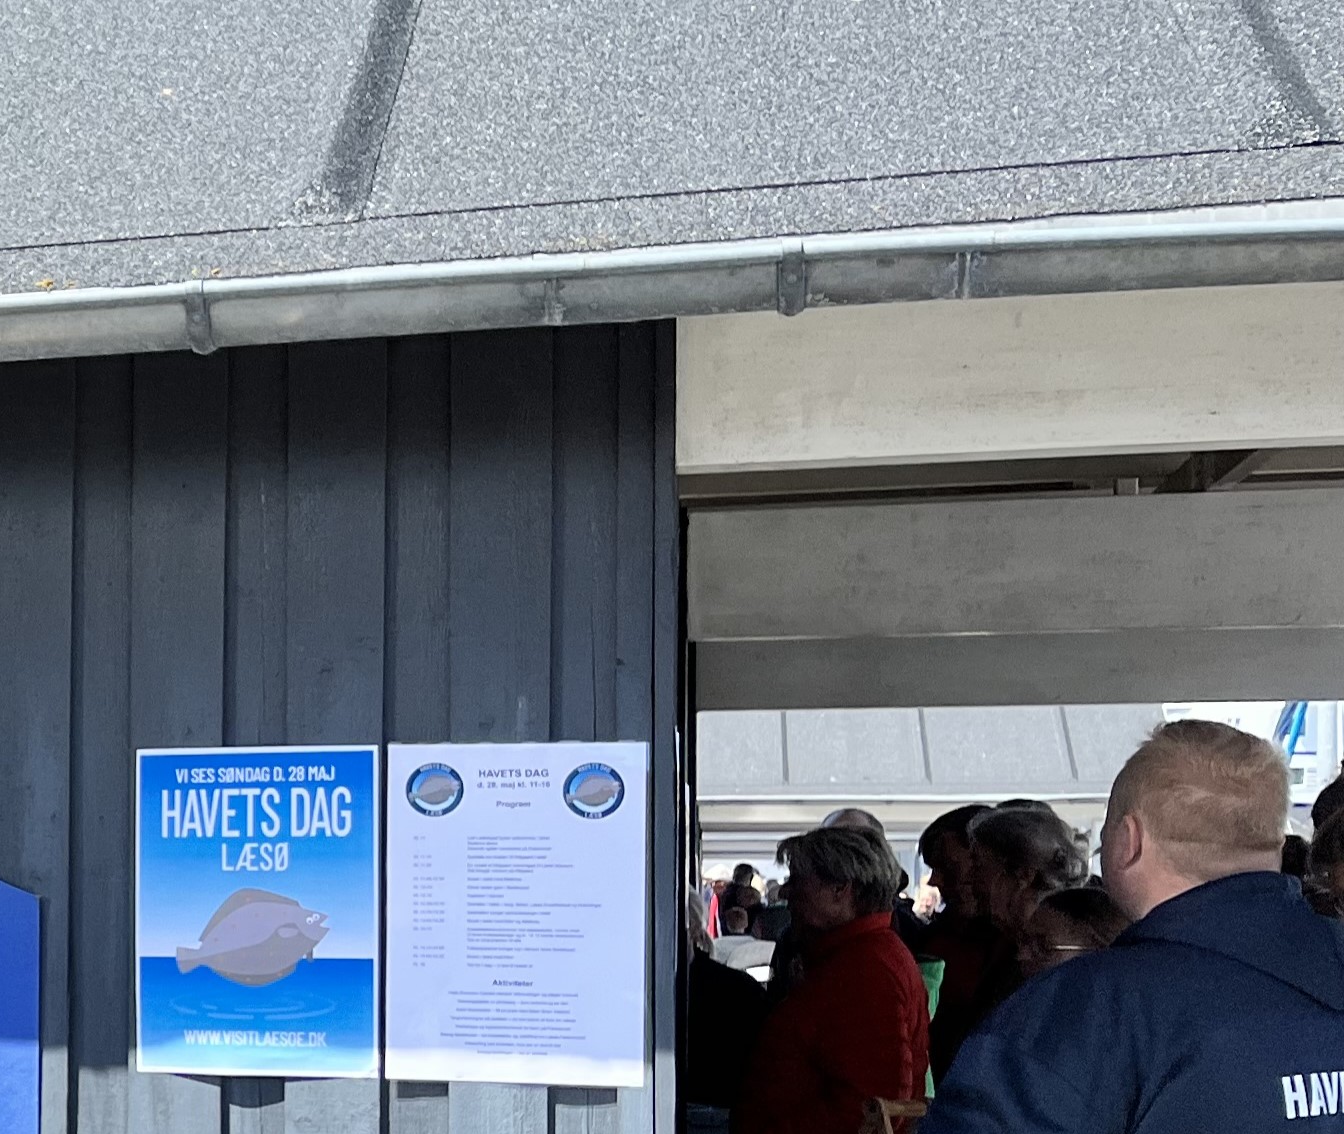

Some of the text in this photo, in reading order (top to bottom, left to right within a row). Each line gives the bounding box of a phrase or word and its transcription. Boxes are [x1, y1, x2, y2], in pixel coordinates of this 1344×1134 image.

[175, 765, 336, 784] VI SES SØNDAG D. 28 MAJ
[478, 768, 550, 778] HAVETS DAG
[500, 781, 516, 790] maj
[161, 786, 352, 838] HAVETS DAG
[221, 841, 289, 872] LÆSØ
[183, 1029, 327, 1048] WWW.VISITLAESOE.DK
[1281, 1071, 1344, 1119] HAV
